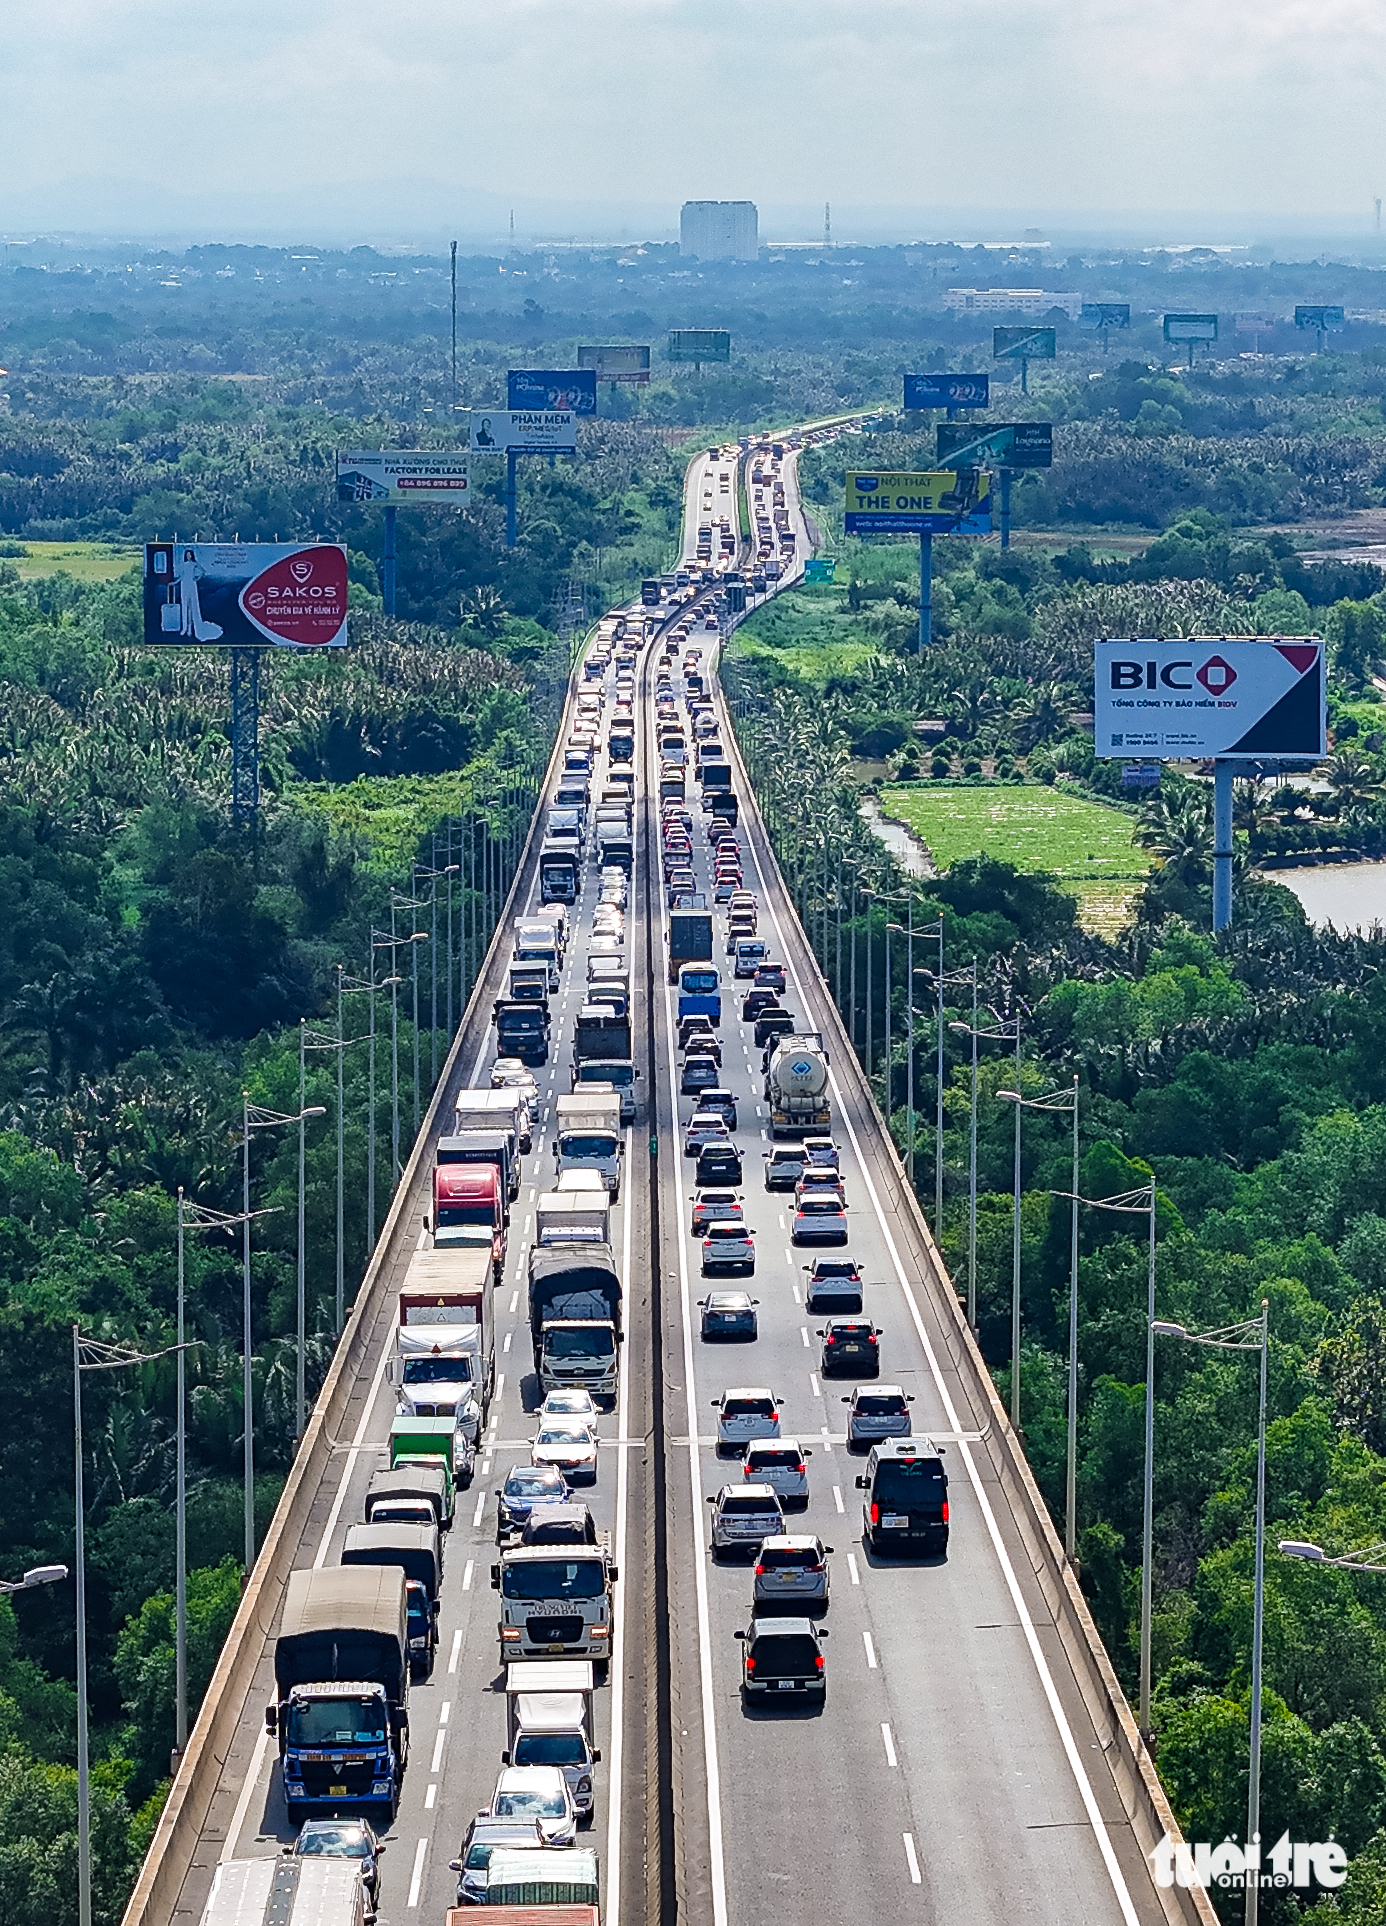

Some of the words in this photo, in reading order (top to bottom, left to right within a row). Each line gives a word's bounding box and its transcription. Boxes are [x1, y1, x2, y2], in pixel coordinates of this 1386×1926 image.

[432, 458, 448, 466] CHO
[384, 467, 423, 475] FACTORY
[425, 467, 441, 475] FOR
[442, 467, 468, 475] LEASE
[880, 475, 900, 488] NỘI
[855, 495, 890, 509] THE
[896, 495, 933, 510] ONE
[267, 586, 337, 598] SAKOS
[1110, 661, 1193, 689] BIC
[1111, 698, 1134, 708] TỔNG
[1136, 699, 1160, 708] CÔNG
[1175, 698, 1193, 708] BẢO
[1195, 698, 1215, 708] HIỂM
